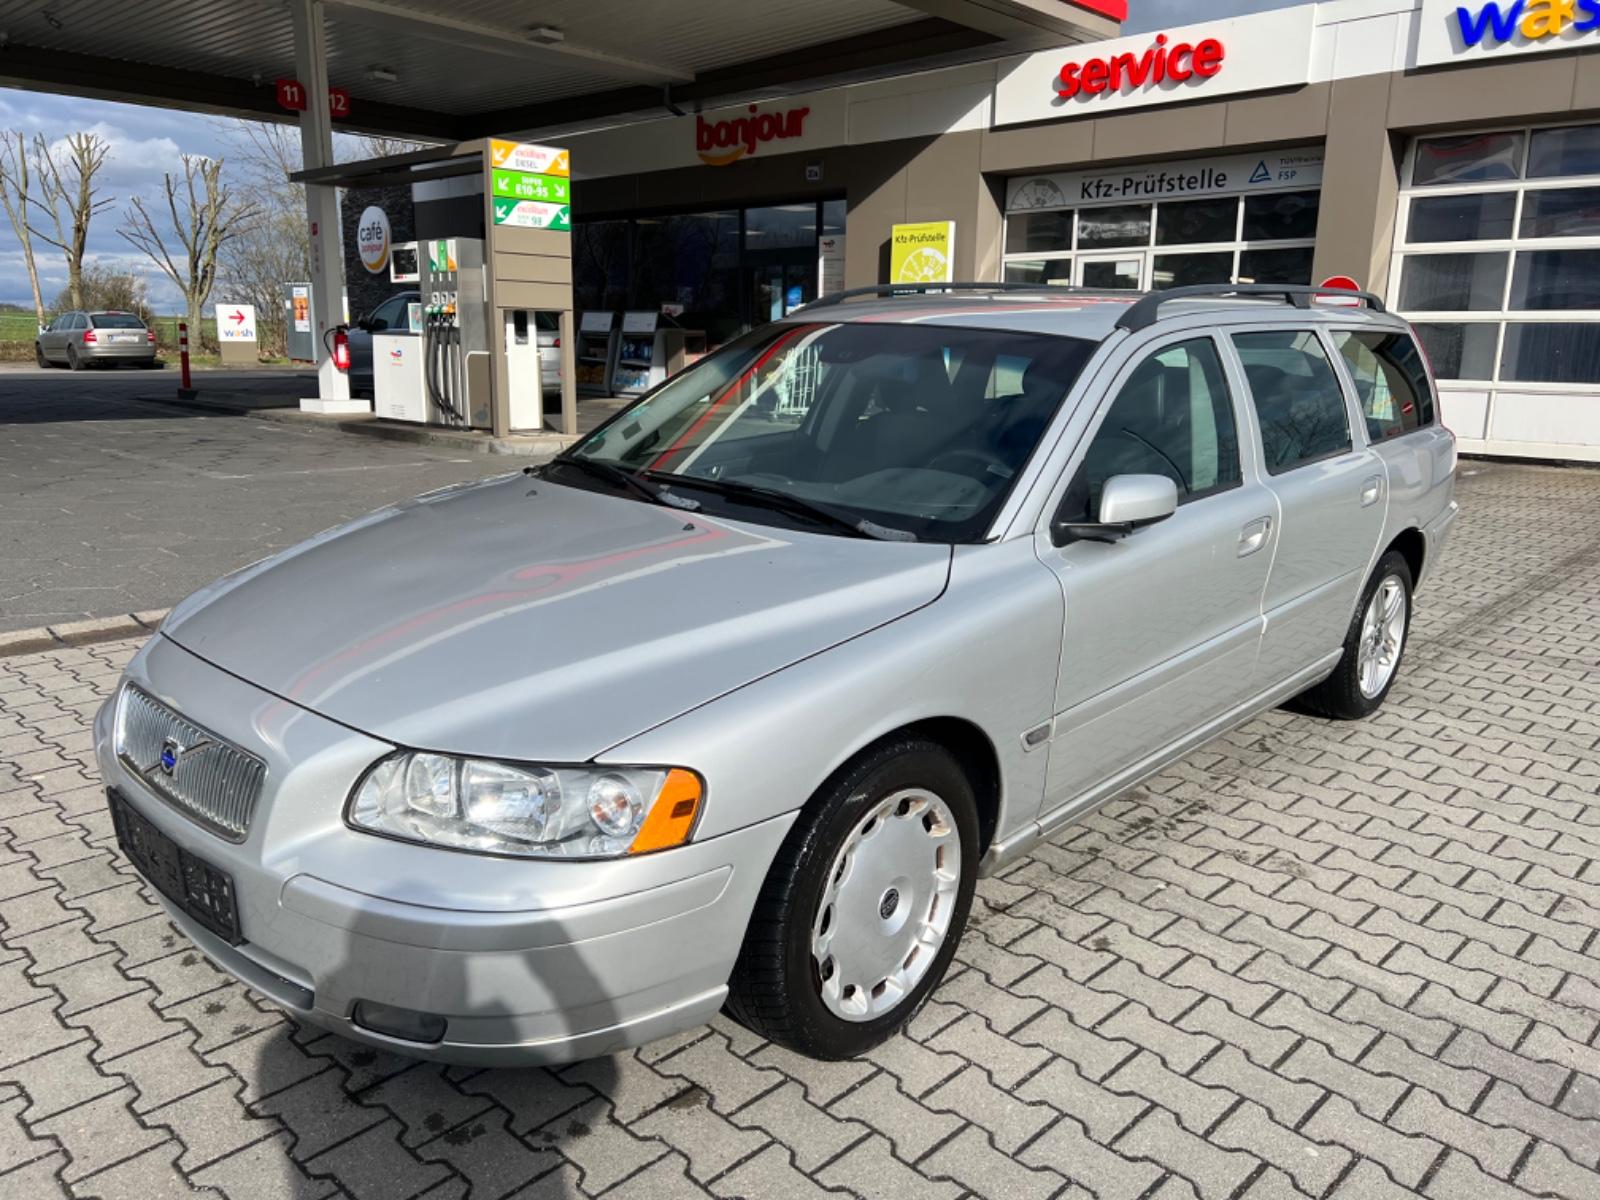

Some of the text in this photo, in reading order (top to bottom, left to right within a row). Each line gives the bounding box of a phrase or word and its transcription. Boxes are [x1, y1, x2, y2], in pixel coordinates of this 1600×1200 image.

[1058, 33, 1224, 98] service
[283, 85, 299, 103] 11
[329, 94, 347, 112] 12
[696, 103, 810, 155] bonjour
[1080, 168, 1228, 200] Kfz-Prüfstelle
[1278, 170, 1298, 181] FSP
[360, 220, 383, 242] café
